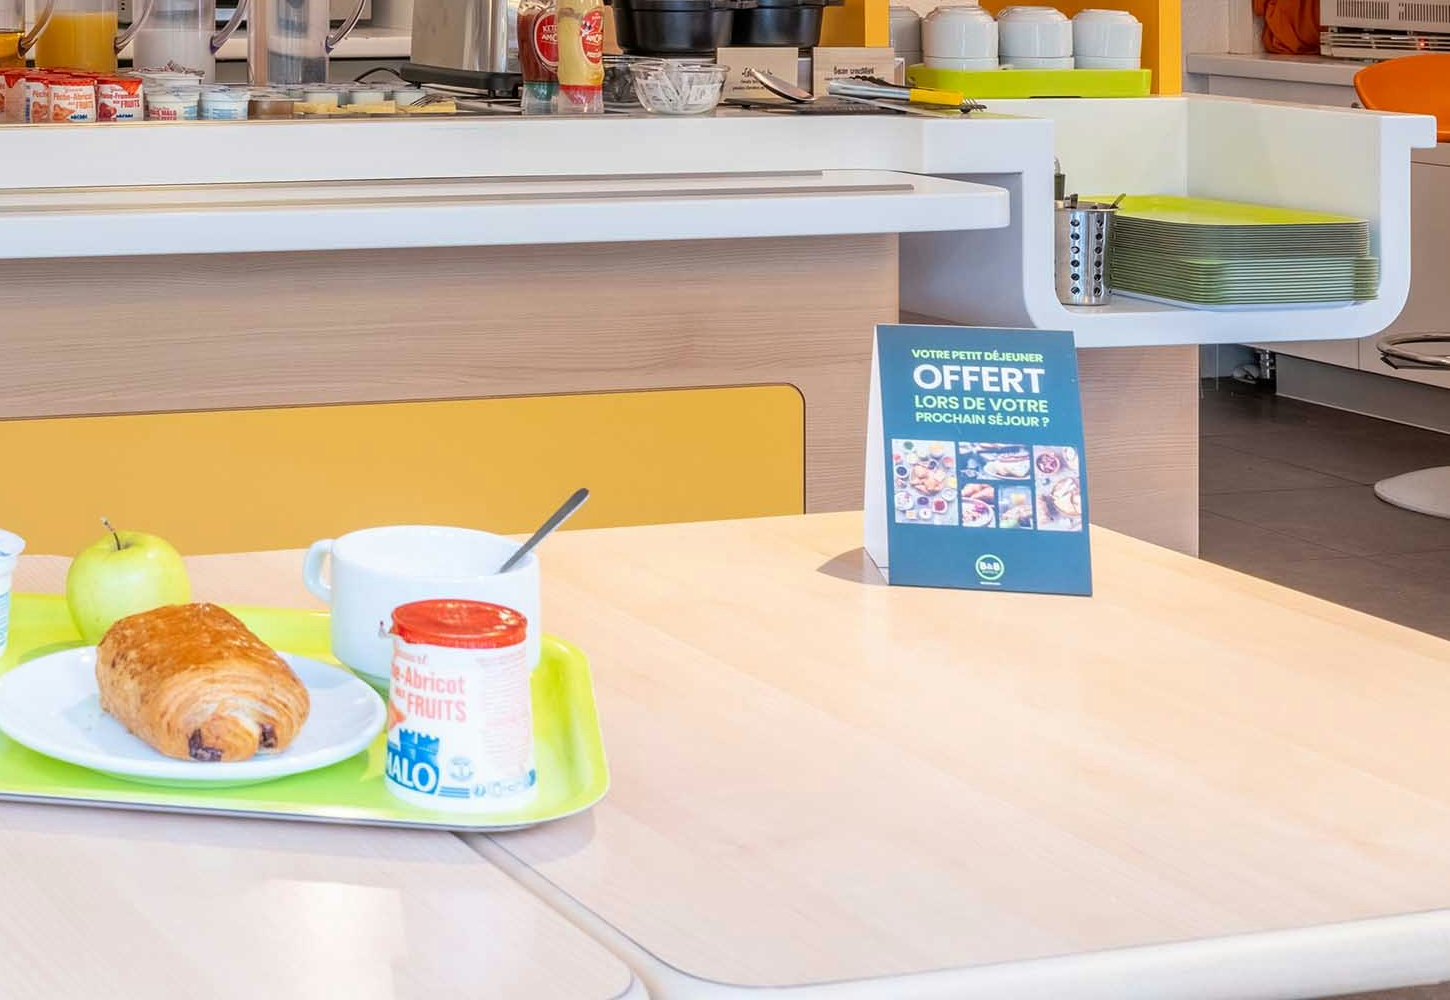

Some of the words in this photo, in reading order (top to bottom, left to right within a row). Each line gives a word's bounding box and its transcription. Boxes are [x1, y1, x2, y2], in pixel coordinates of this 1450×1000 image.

[911, 349, 951, 360] VOTRE
[951, 350, 983, 361] PETIT
[984, 349, 1044, 364] DÉJEUNER
[913, 363, 1046, 394] OFFERT
[914, 395, 960, 410] LORS
[963, 397, 986, 411] DE
[989, 397, 1049, 414] VOTRE
[915, 411, 986, 426] PROCHAIN
[987, 413, 1040, 427] SÉJOUR
[1041, 417, 1050, 428] ?
[391, 665, 466, 696] e-Abricot
[407, 693, 468, 723] FRUITS
